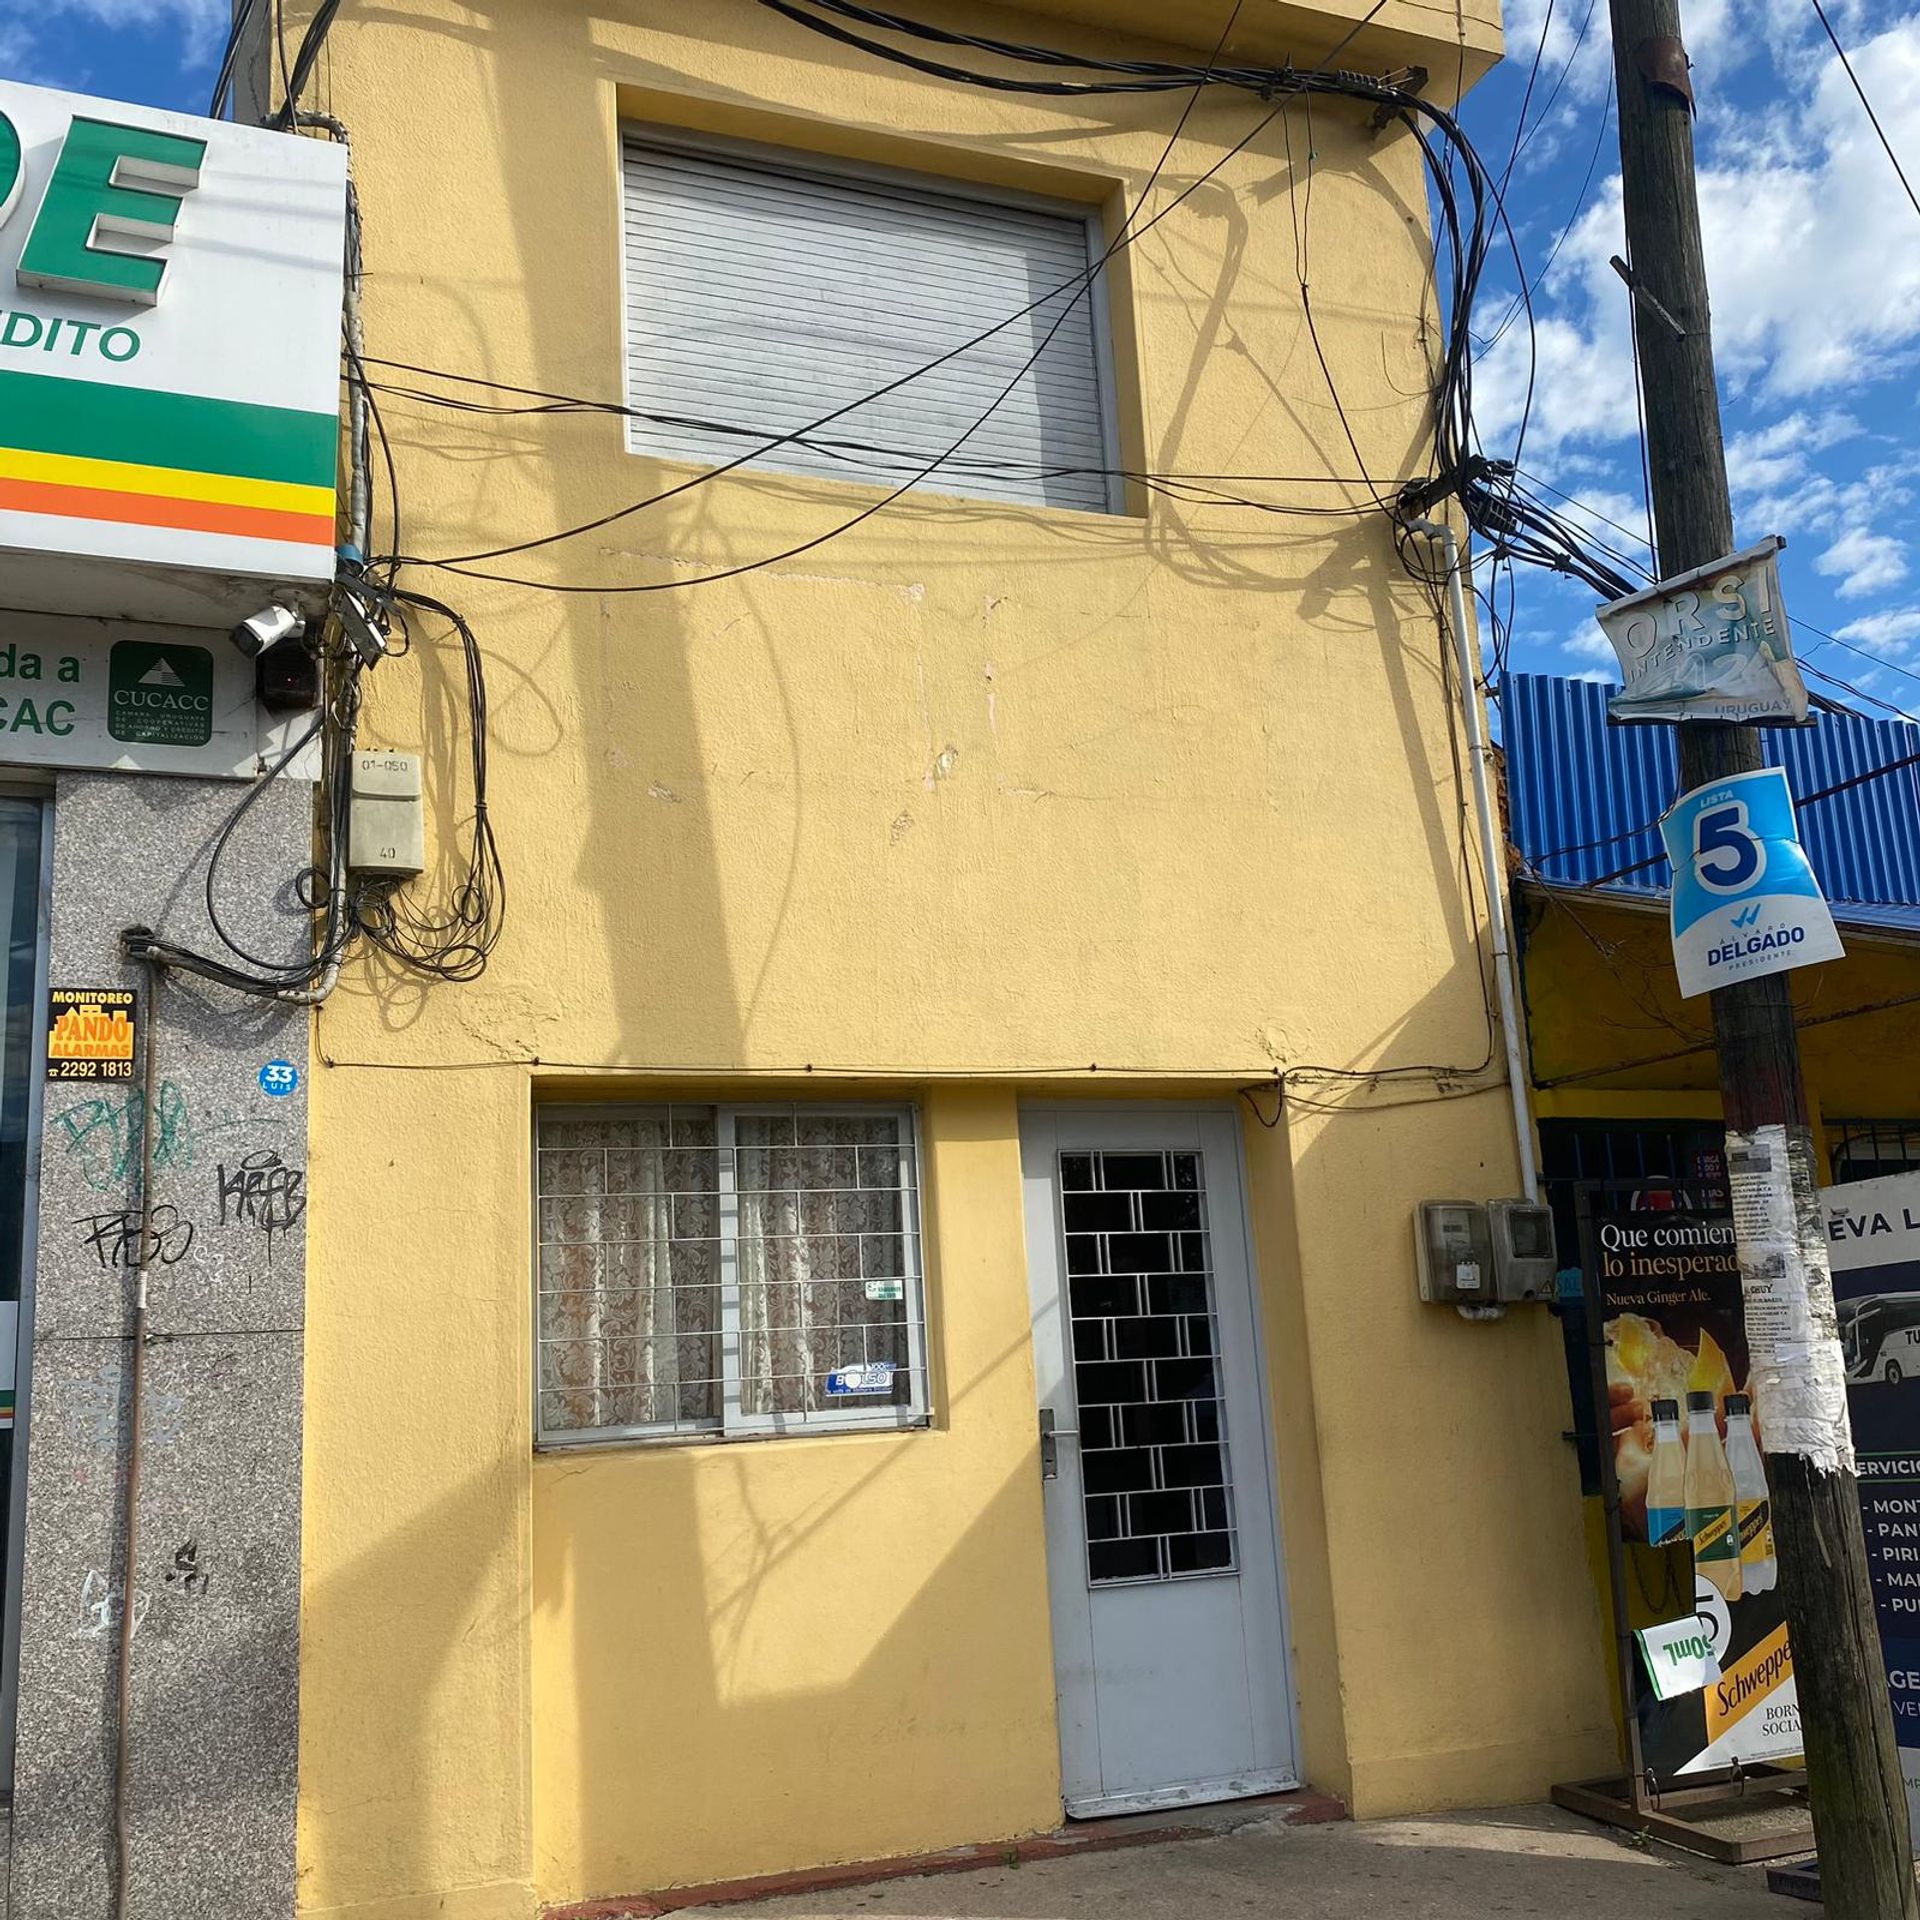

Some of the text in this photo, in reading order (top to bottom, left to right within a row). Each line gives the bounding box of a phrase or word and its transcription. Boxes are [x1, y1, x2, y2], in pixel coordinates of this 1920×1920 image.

[0, 110, 208, 306] E
[0, 310, 141, 362] DITO
[1624, 565, 1772, 660] ORSI
[1628, 618, 1776, 685] INTENDENTE
[0, 643, 80, 683] da a
[114, 689, 208, 711] CUCACC
[361, 759, 409, 772] 01-050
[1700, 789, 1735, 808] LISTA
[379, 846, 397, 859] 40
[1697, 804, 1762, 890] 5
[1707, 926, 1805, 967] DELGADO
[1728, 949, 1792, 971] PRESIDENTE
[52, 991, 134, 1005] MONITOREO
[55, 1016, 129, 1042] PANDO
[51, 1043, 130, 1057] ALARMAS
[60, 1061, 132, 1077] 2292 1813
[265, 1064, 294, 1083] 33
[1600, 1221, 1736, 1252] Que comien
[1828, 1212, 1893, 1241] EVA
[1603, 1252, 1624, 1277] lo
[1606, 1293, 1645, 1306] Nueva
[1647, 1290, 1687, 1306] Ginger
[1856, 1460, 1920, 1476] ERVICI
[1878, 1522, 1920, 1537] PAN
[1882, 1547, 1919, 1561] PIRI
[1892, 1598, 1920, 1613] PU
[1716, 1640, 1793, 1717] Schweppe
[1887, 1670, 1920, 1690] GE
